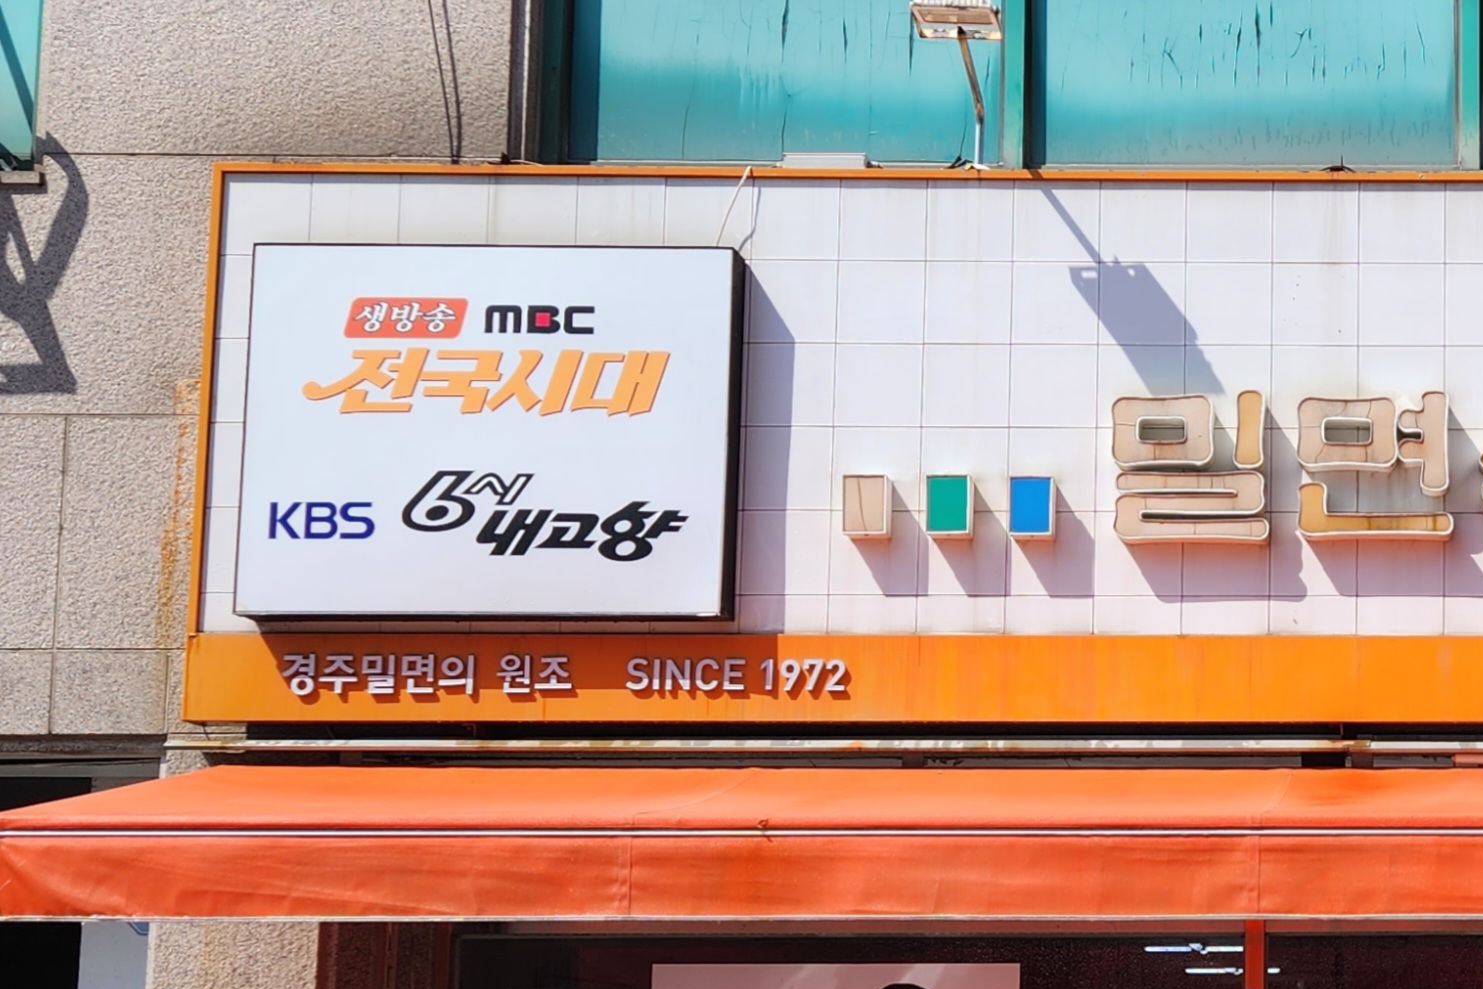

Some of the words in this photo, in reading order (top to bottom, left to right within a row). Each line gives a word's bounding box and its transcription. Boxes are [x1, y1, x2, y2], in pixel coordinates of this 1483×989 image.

[352, 302, 456, 334] 생방송
[302, 347, 671, 416] 전국시대
[268, 501, 375, 539] KBS
[282, 653, 475, 696] 경주밀면의
[496, 655, 573, 694] 원조
[625, 656, 745, 692] SINCE
[760, 657, 846, 692] 1972
